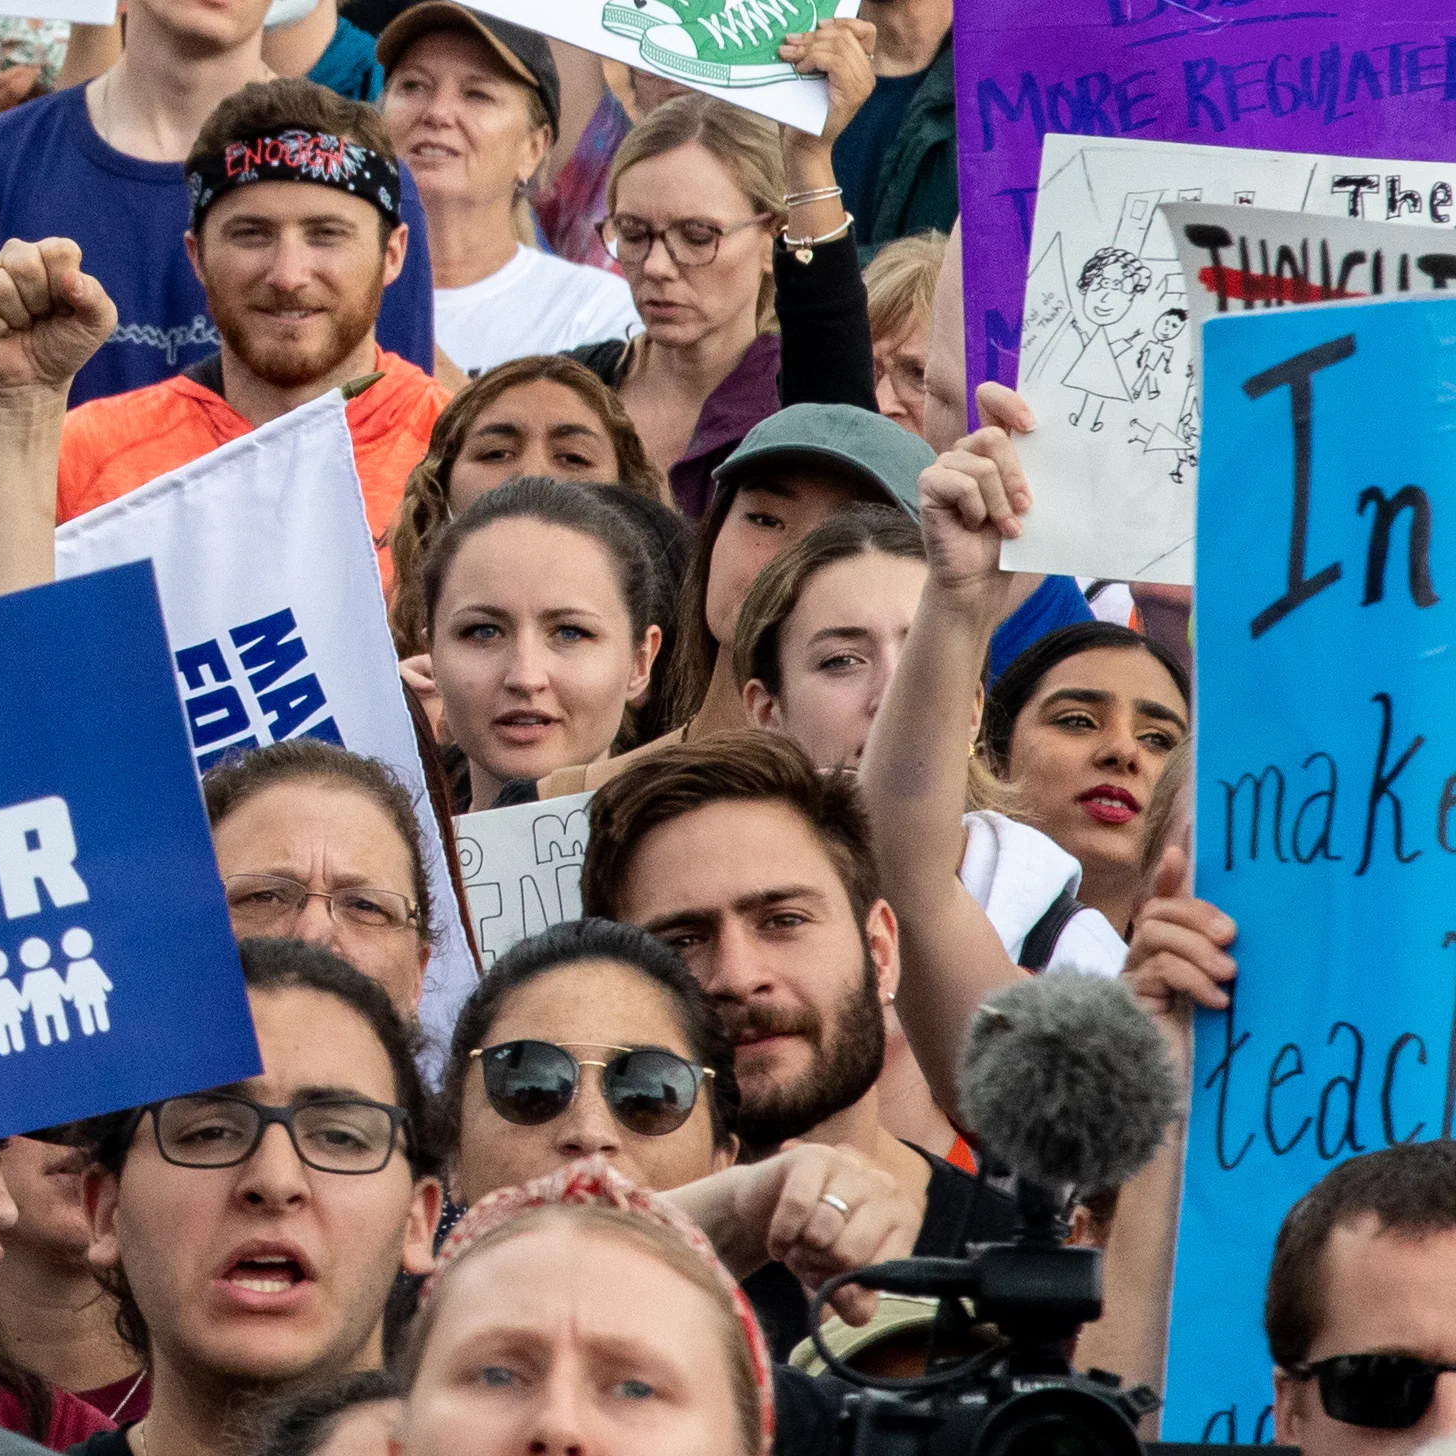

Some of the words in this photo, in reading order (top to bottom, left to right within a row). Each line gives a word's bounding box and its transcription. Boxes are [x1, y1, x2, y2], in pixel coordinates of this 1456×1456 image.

[976, 66, 1159, 154] MORE
[1181, 34, 1456, 136] REGULATE
[223, 133, 347, 178] ENOUGH
[1330, 174, 1454, 224] The
[1240, 332, 1442, 642] In
